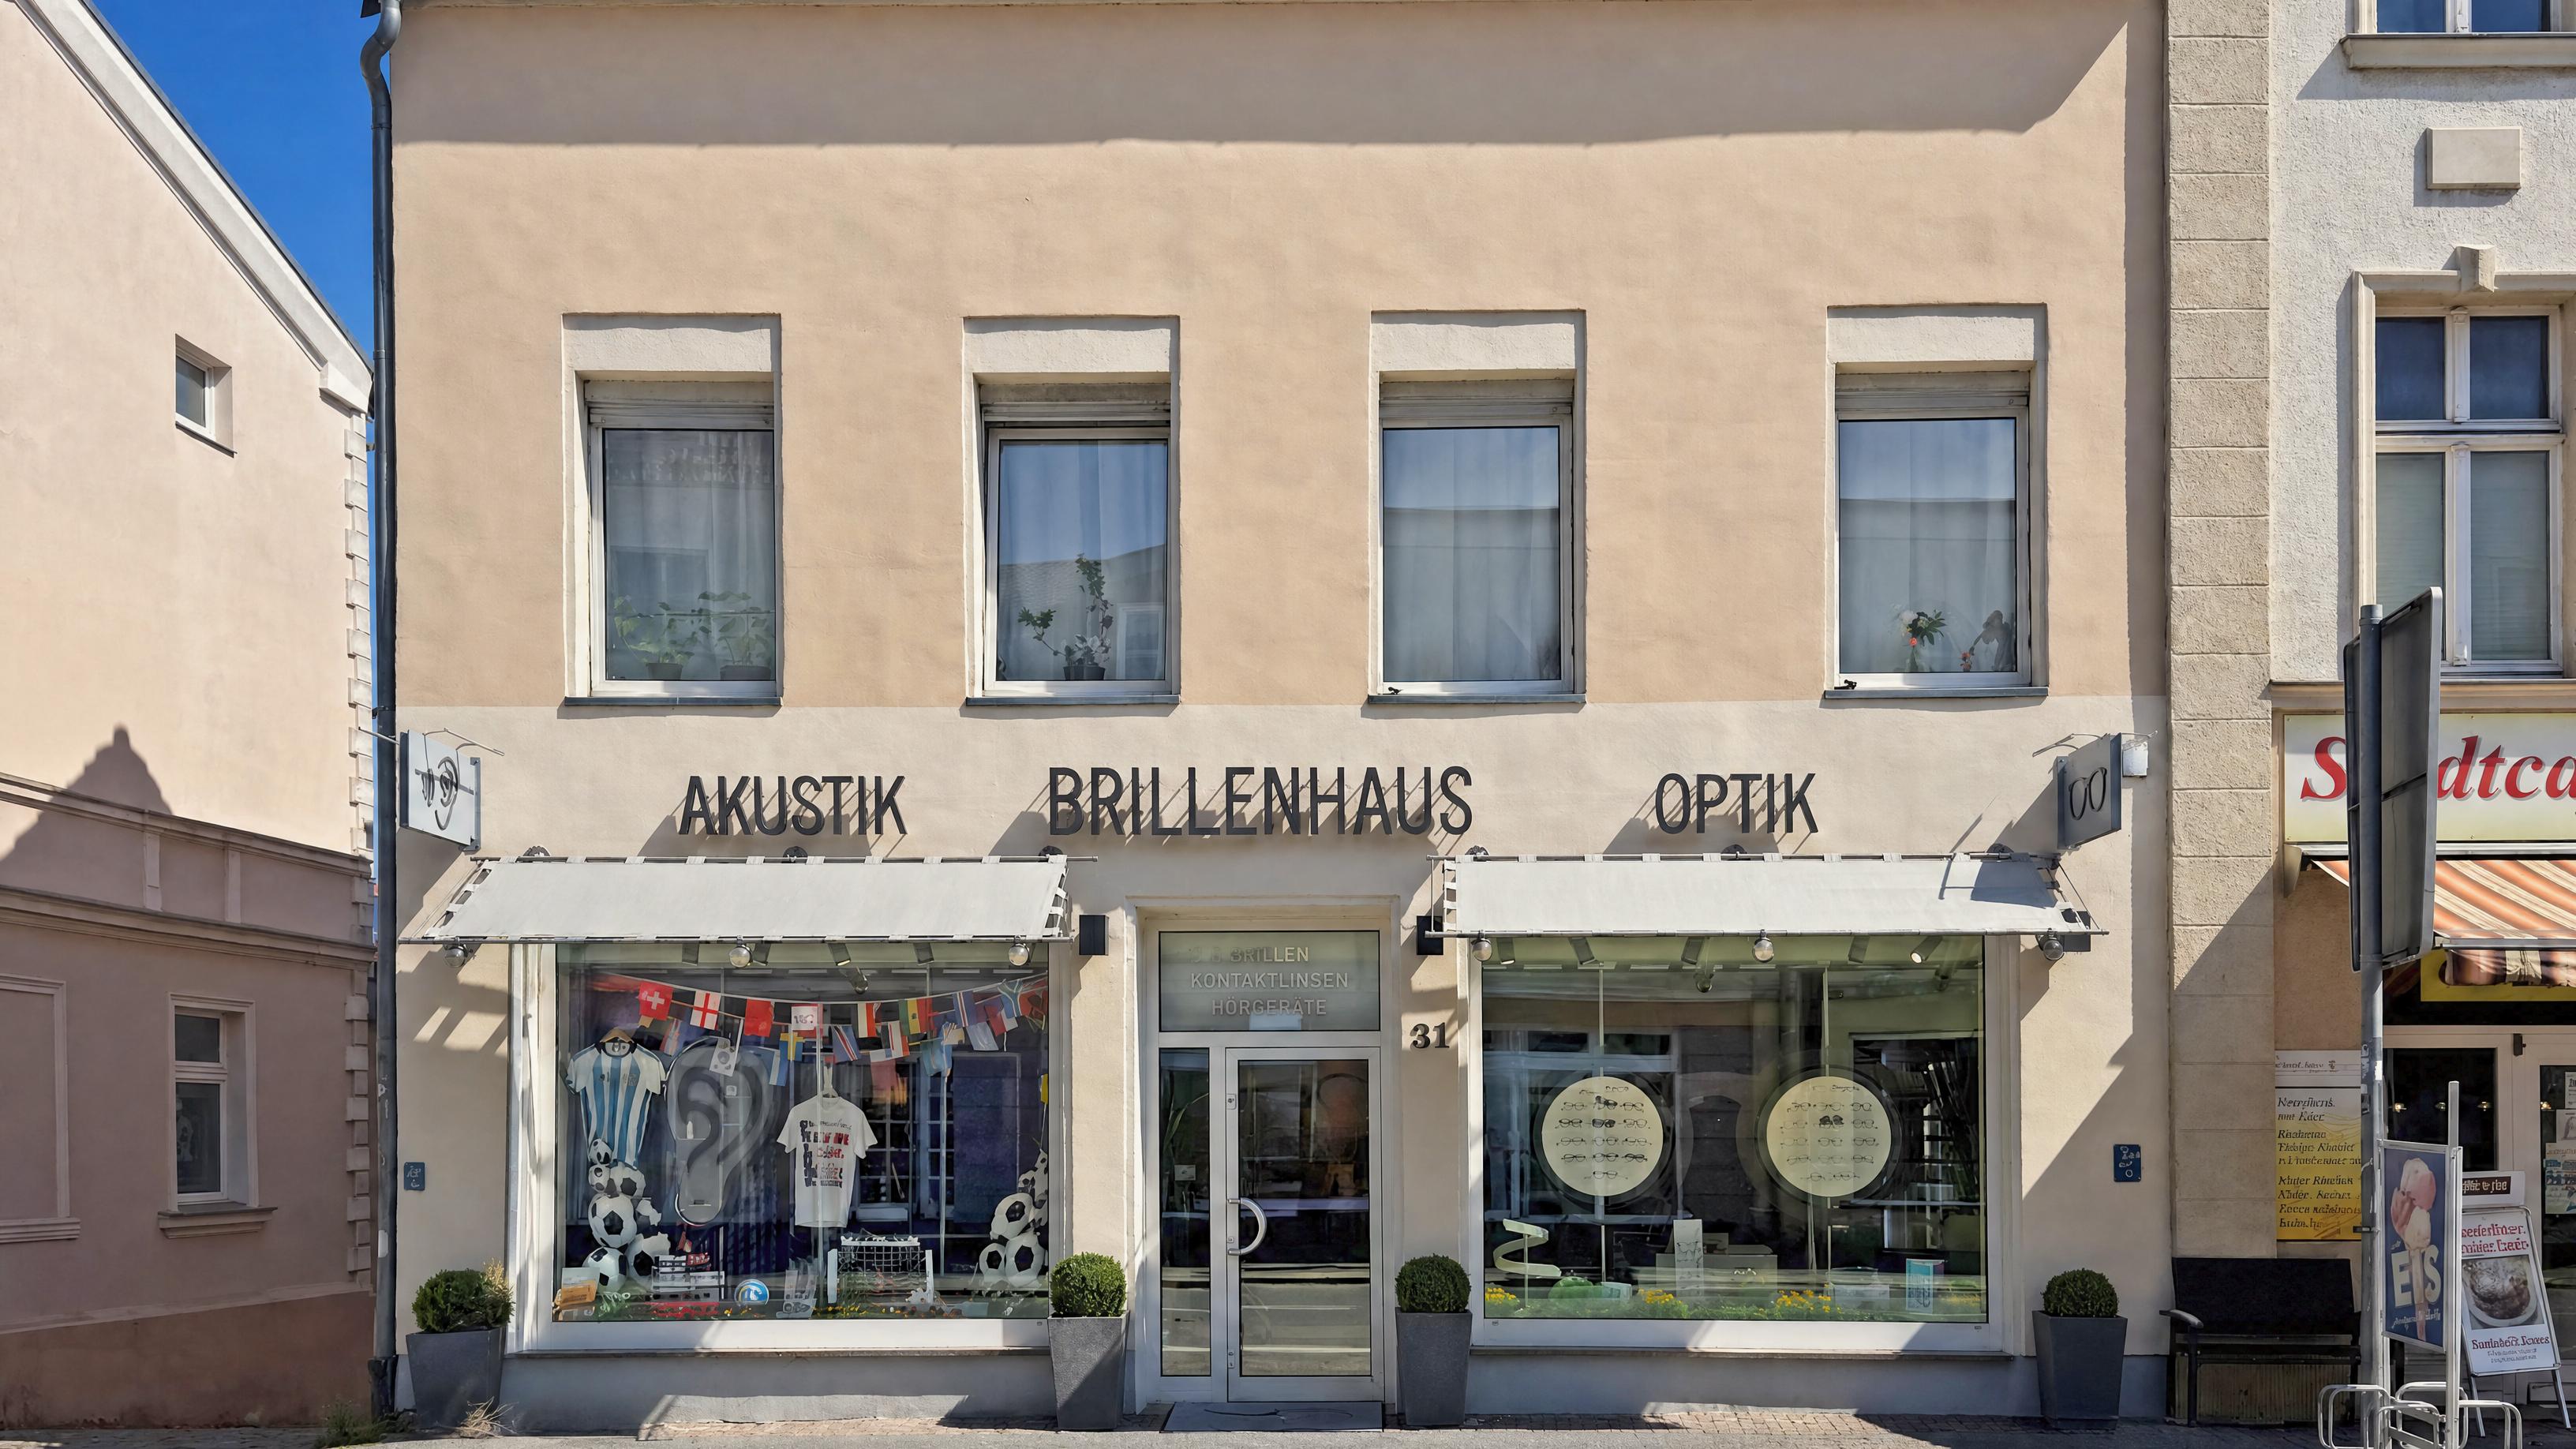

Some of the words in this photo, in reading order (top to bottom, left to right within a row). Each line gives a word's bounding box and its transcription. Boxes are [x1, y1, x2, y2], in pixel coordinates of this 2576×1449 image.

[2300, 735, 2576, 800] Sdtca
[679, 775, 908, 835] AKUSTIK
[1049, 766, 1473, 836] BRILLENHAUS
[1655, 773, 1818, 834] OPTIK
[1230, 946, 1309, 963] BRILLEN
[1190, 972, 1350, 989] KONTAKTLINSEN
[1211, 997, 1327, 1016] HÖRGERÄTE
[1411, 1022, 1451, 1049] 31
